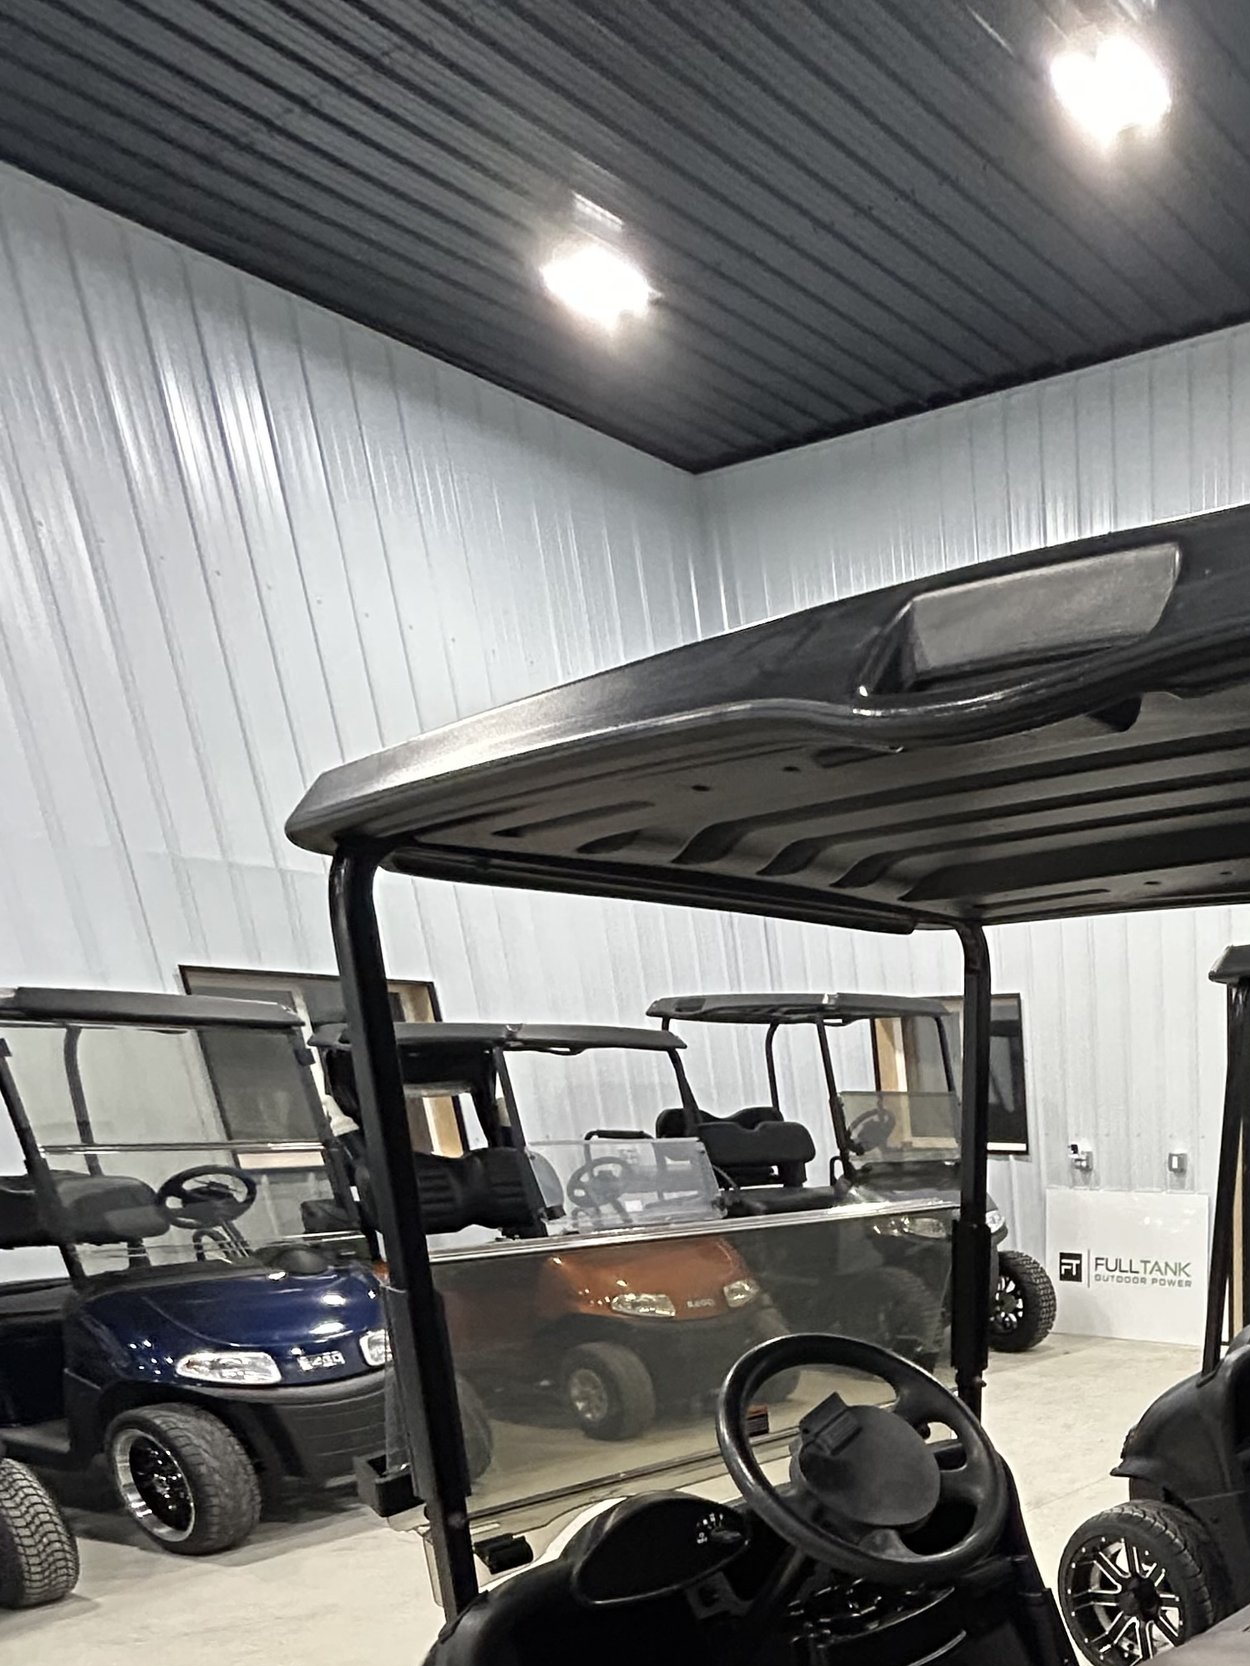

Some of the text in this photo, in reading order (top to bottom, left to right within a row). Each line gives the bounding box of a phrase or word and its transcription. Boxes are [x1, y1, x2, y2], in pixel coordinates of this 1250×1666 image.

[1094, 1257, 1192, 1277] FULLTANK
[1094, 1275, 1193, 1288] OUTDOOR POWER
